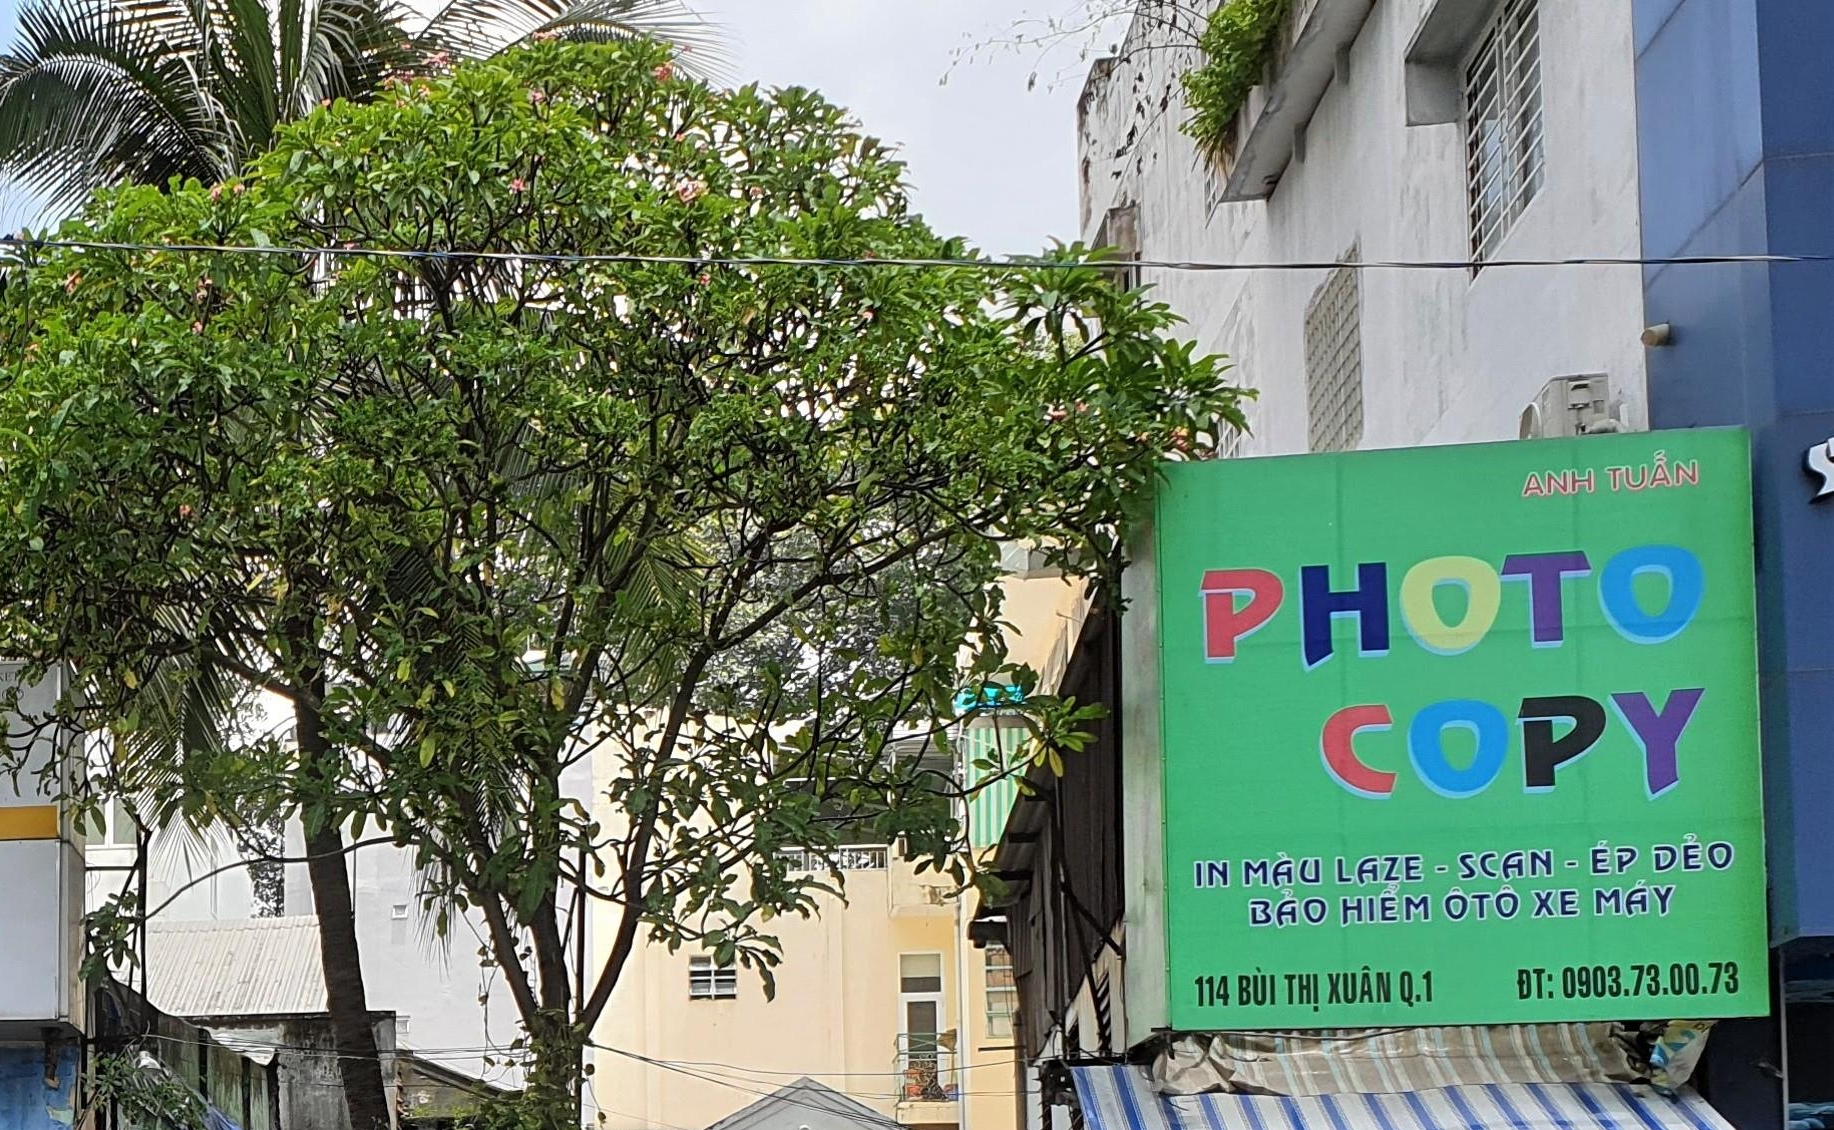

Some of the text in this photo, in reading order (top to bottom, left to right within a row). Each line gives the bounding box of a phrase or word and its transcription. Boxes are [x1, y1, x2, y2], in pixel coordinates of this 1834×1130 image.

[1522, 451, 1700, 498] ANH TUẤN
[1200, 544, 1704, 671] PHOTO
[1320, 688, 1706, 800] COPY
[1194, 861, 1230, 889] IN
[1242, 851, 1323, 889] MÀU
[1337, 855, 1424, 885] LAZE
[1459, 849, 1554, 881] SCAN
[1591, 841, 1640, 876] ÉP
[1654, 833, 1734, 872] DẺO
[1249, 880, 1677, 928] BẢO HIỂM ÔTÔ XE MÁY
[1195, 966, 1434, 1012] 114 BÙI THỊ XUÂN Q.1
[1562, 961, 1740, 999] 0903.73.00.73
